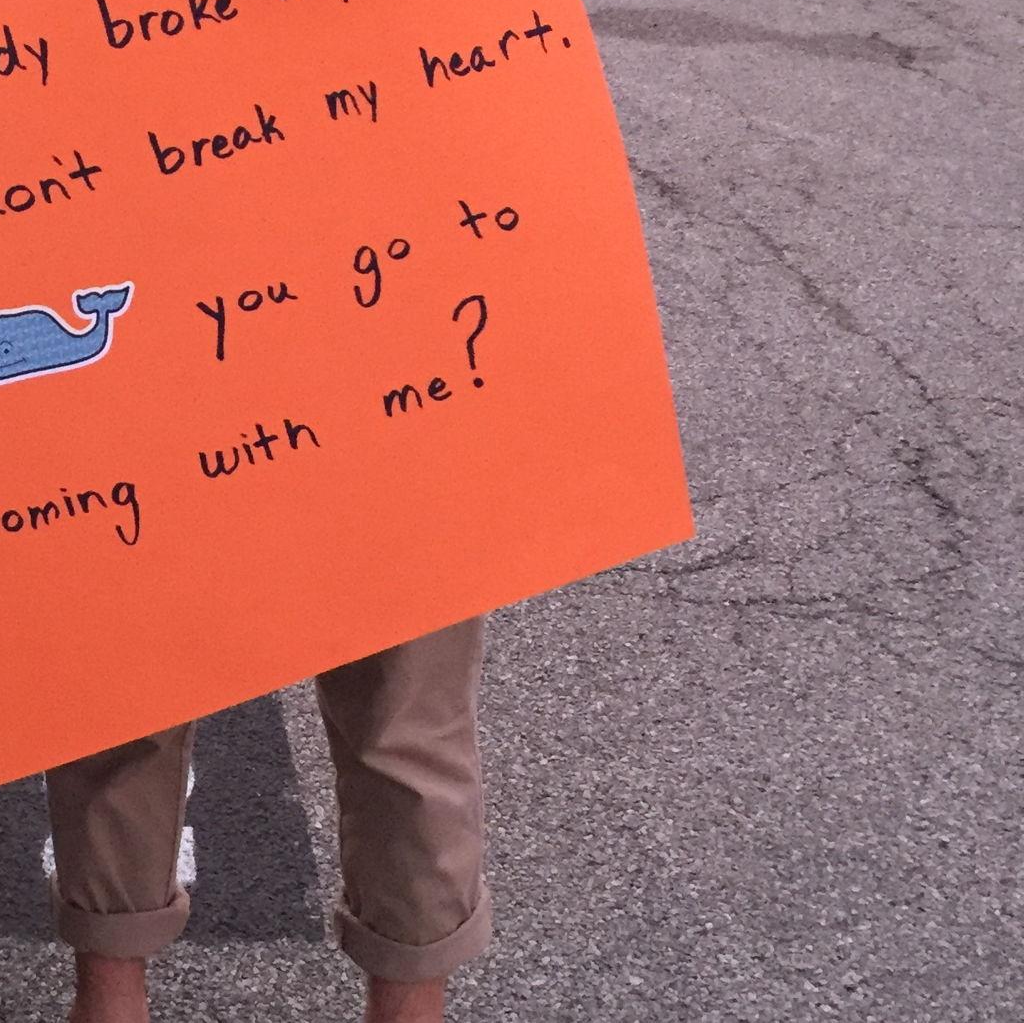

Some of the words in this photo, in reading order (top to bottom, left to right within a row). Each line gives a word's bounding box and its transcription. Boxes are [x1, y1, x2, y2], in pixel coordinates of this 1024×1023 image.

[147, 104, 285, 176] break
[324, 81, 377, 123] my
[419, 11, 572, 88] heart.
[196, 282, 298, 362] you
[353, 238, 411, 308] go
[458, 200, 519, 239] to
[198, 419, 320, 479] with
[383, 294, 488, 418] me?
